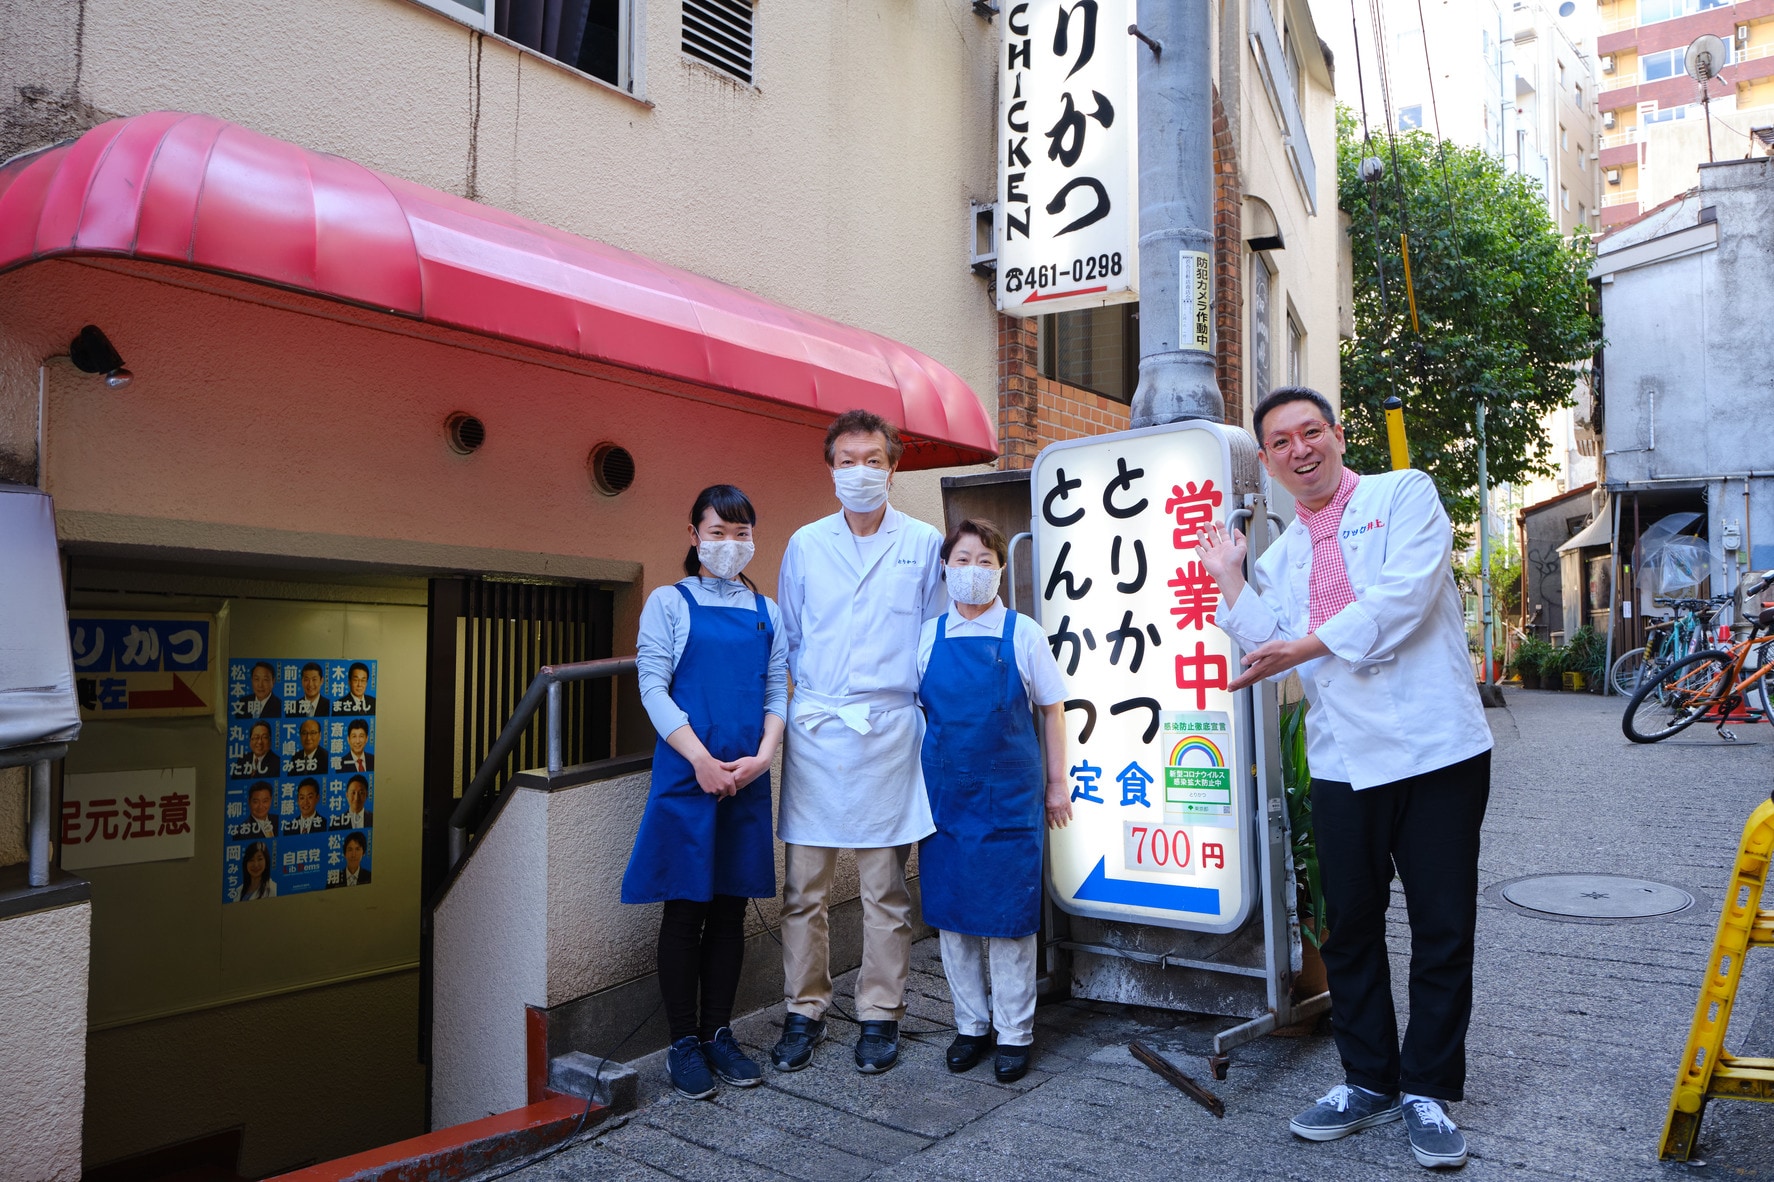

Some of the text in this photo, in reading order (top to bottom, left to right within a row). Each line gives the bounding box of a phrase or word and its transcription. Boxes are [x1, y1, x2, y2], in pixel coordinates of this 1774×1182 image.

[1007, 3, 1032, 241] CHICKEN
[1044, 0, 1115, 239] りかつ
[1024, 251, 1123, 289] 461-0298
[1196, 256, 1208, 346] 防犯カメラ作動中
[1042, 467, 1097, 744] とんかつ
[1102, 457, 1162, 744] とりかつ
[1165, 479, 1229, 711] 営業中
[72, 625, 204, 667] りかつ
[230, 664, 246, 698] 松本
[283, 665, 298, 697] 前田
[331, 665, 346, 697] 木村
[231, 700, 262, 715] 文明
[283, 700, 311, 715] 和茂
[332, 700, 372, 712] まさよし
[229, 725, 245, 759] 丸山
[1163, 722, 1226, 731] 感染防止徹底宣言
[229, 761, 269, 776] たかし
[282, 758, 318, 773] みちお
[1169, 770, 1225, 779] 新型コロナウイルス
[329, 778, 343, 811] 中村
[1069, 759, 1154, 808] 定食
[1173, 778, 1222, 787] 感染拡大防止中
[60, 791, 191, 845] 足元注意
[226, 789, 244, 818] 一柳
[226, 845, 242, 899] 岡みちる
[282, 865, 297, 874] Lib
[283, 848, 321, 866] 自民党
